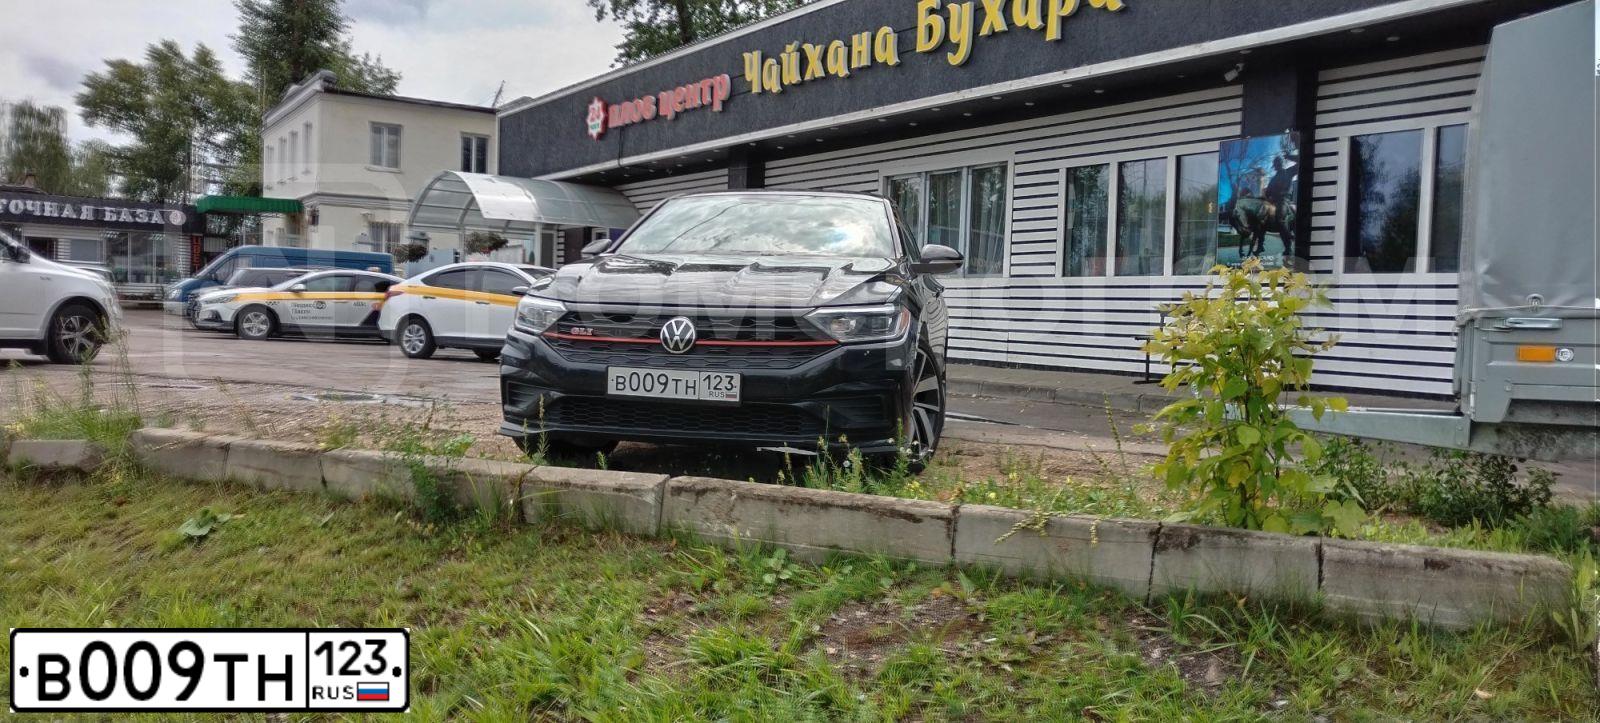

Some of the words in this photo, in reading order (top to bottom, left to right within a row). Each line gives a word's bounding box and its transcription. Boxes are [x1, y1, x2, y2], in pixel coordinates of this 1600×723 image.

[743, 26, 900, 93] Чайхана
[916, 0, 1125, 66] Бухар
[104, 206, 165, 224] БАЗА
[570, 327, 593, 336] GLI
[702, 374, 735, 392] 123
[709, 390, 725, 398] RUS
